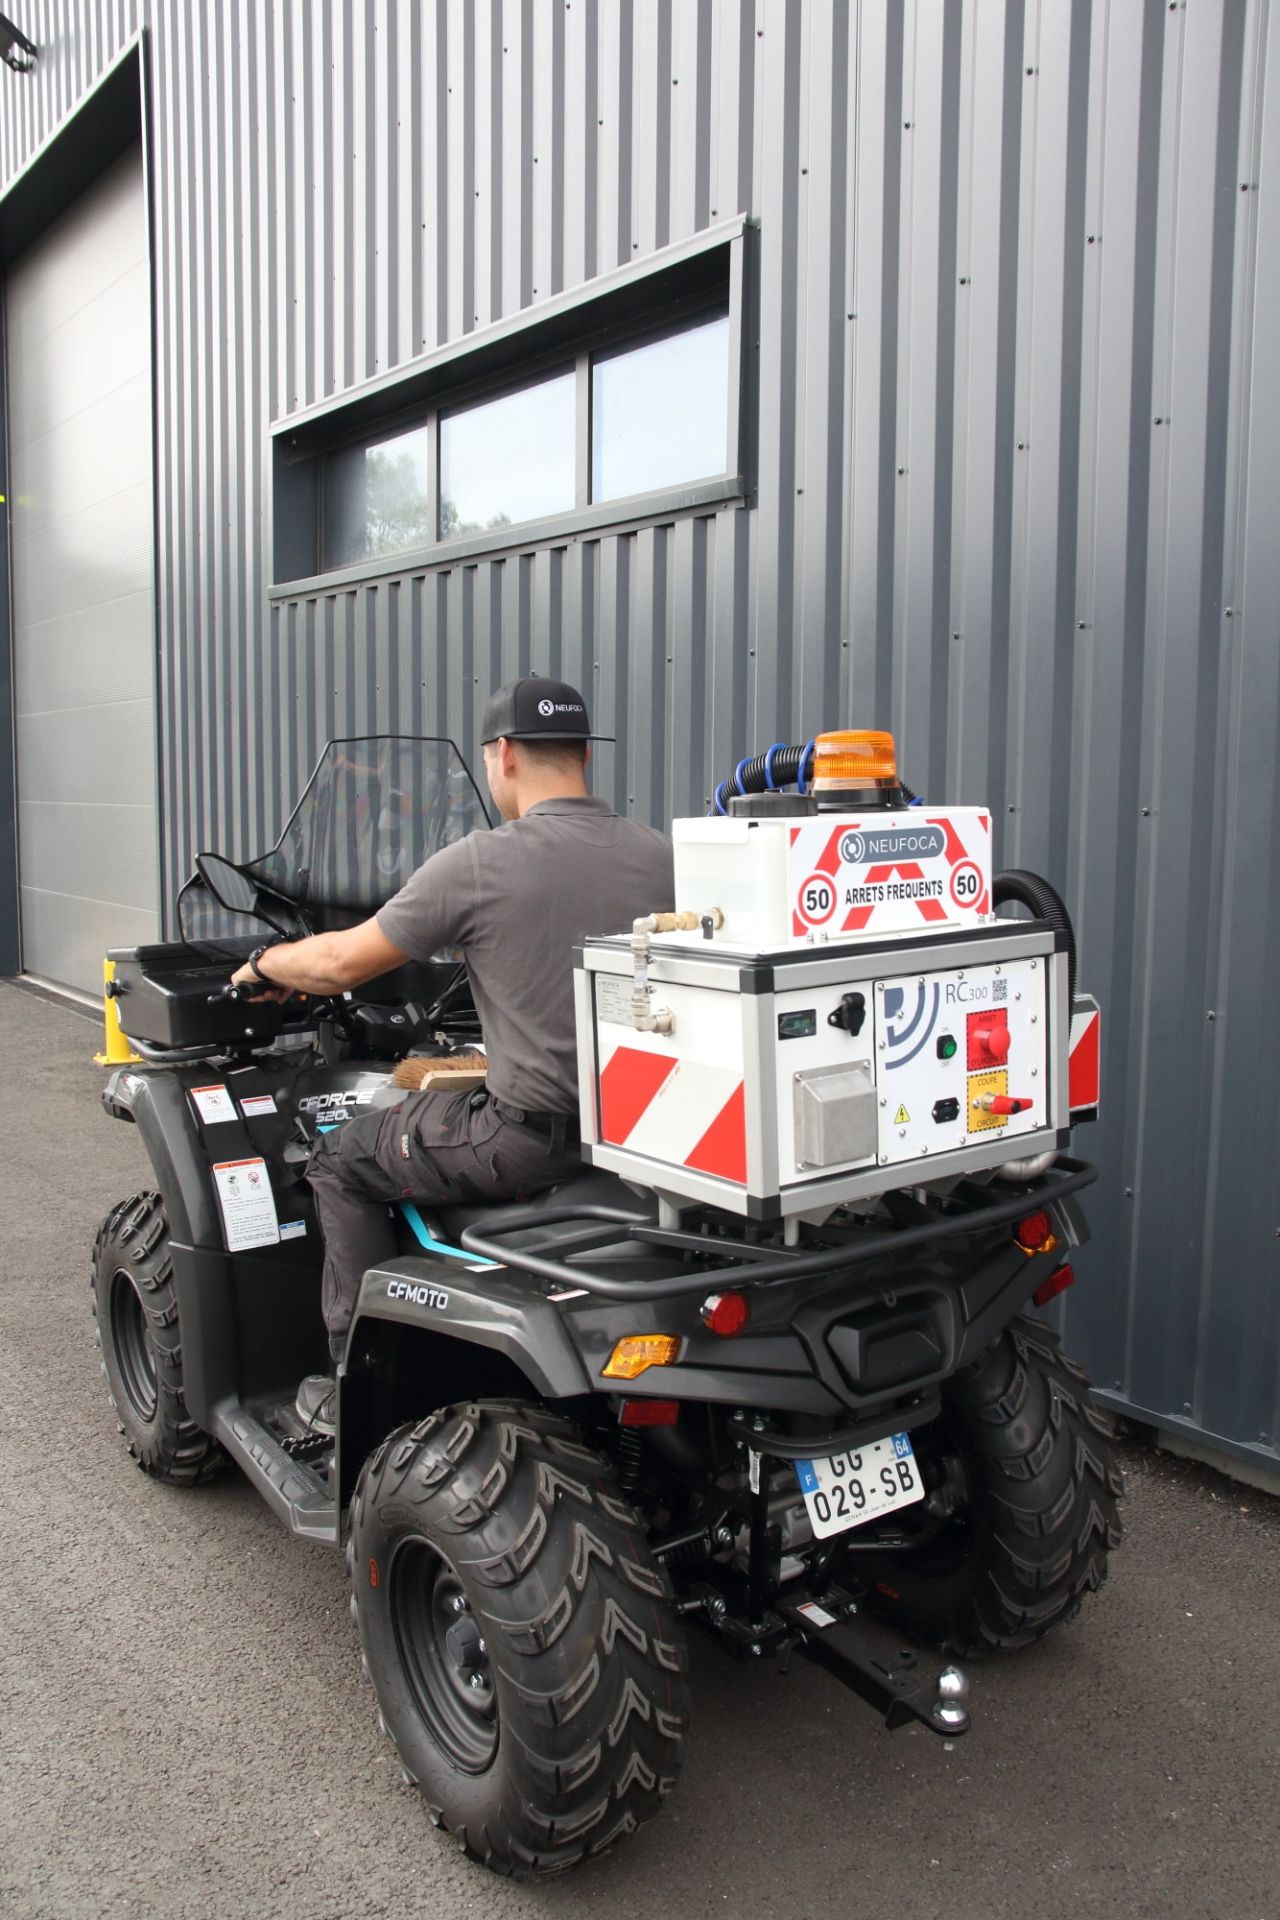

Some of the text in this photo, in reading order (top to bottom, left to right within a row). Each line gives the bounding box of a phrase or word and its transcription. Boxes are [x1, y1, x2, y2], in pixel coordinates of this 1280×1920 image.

[869, 836, 937, 854] NEUFOCA
[845, 880, 943, 905] ARRETS FREQUENTS
[957, 874, 977, 895] 50
[806, 889, 829, 911] 50
[977, 1075, 998, 1087] COUPE
[298, 1090, 376, 1112] CFORCE
[387, 1281, 449, 1310] CFMOTO
[895, 1437, 909, 1456] 64
[805, 1474, 812, 1487] F
